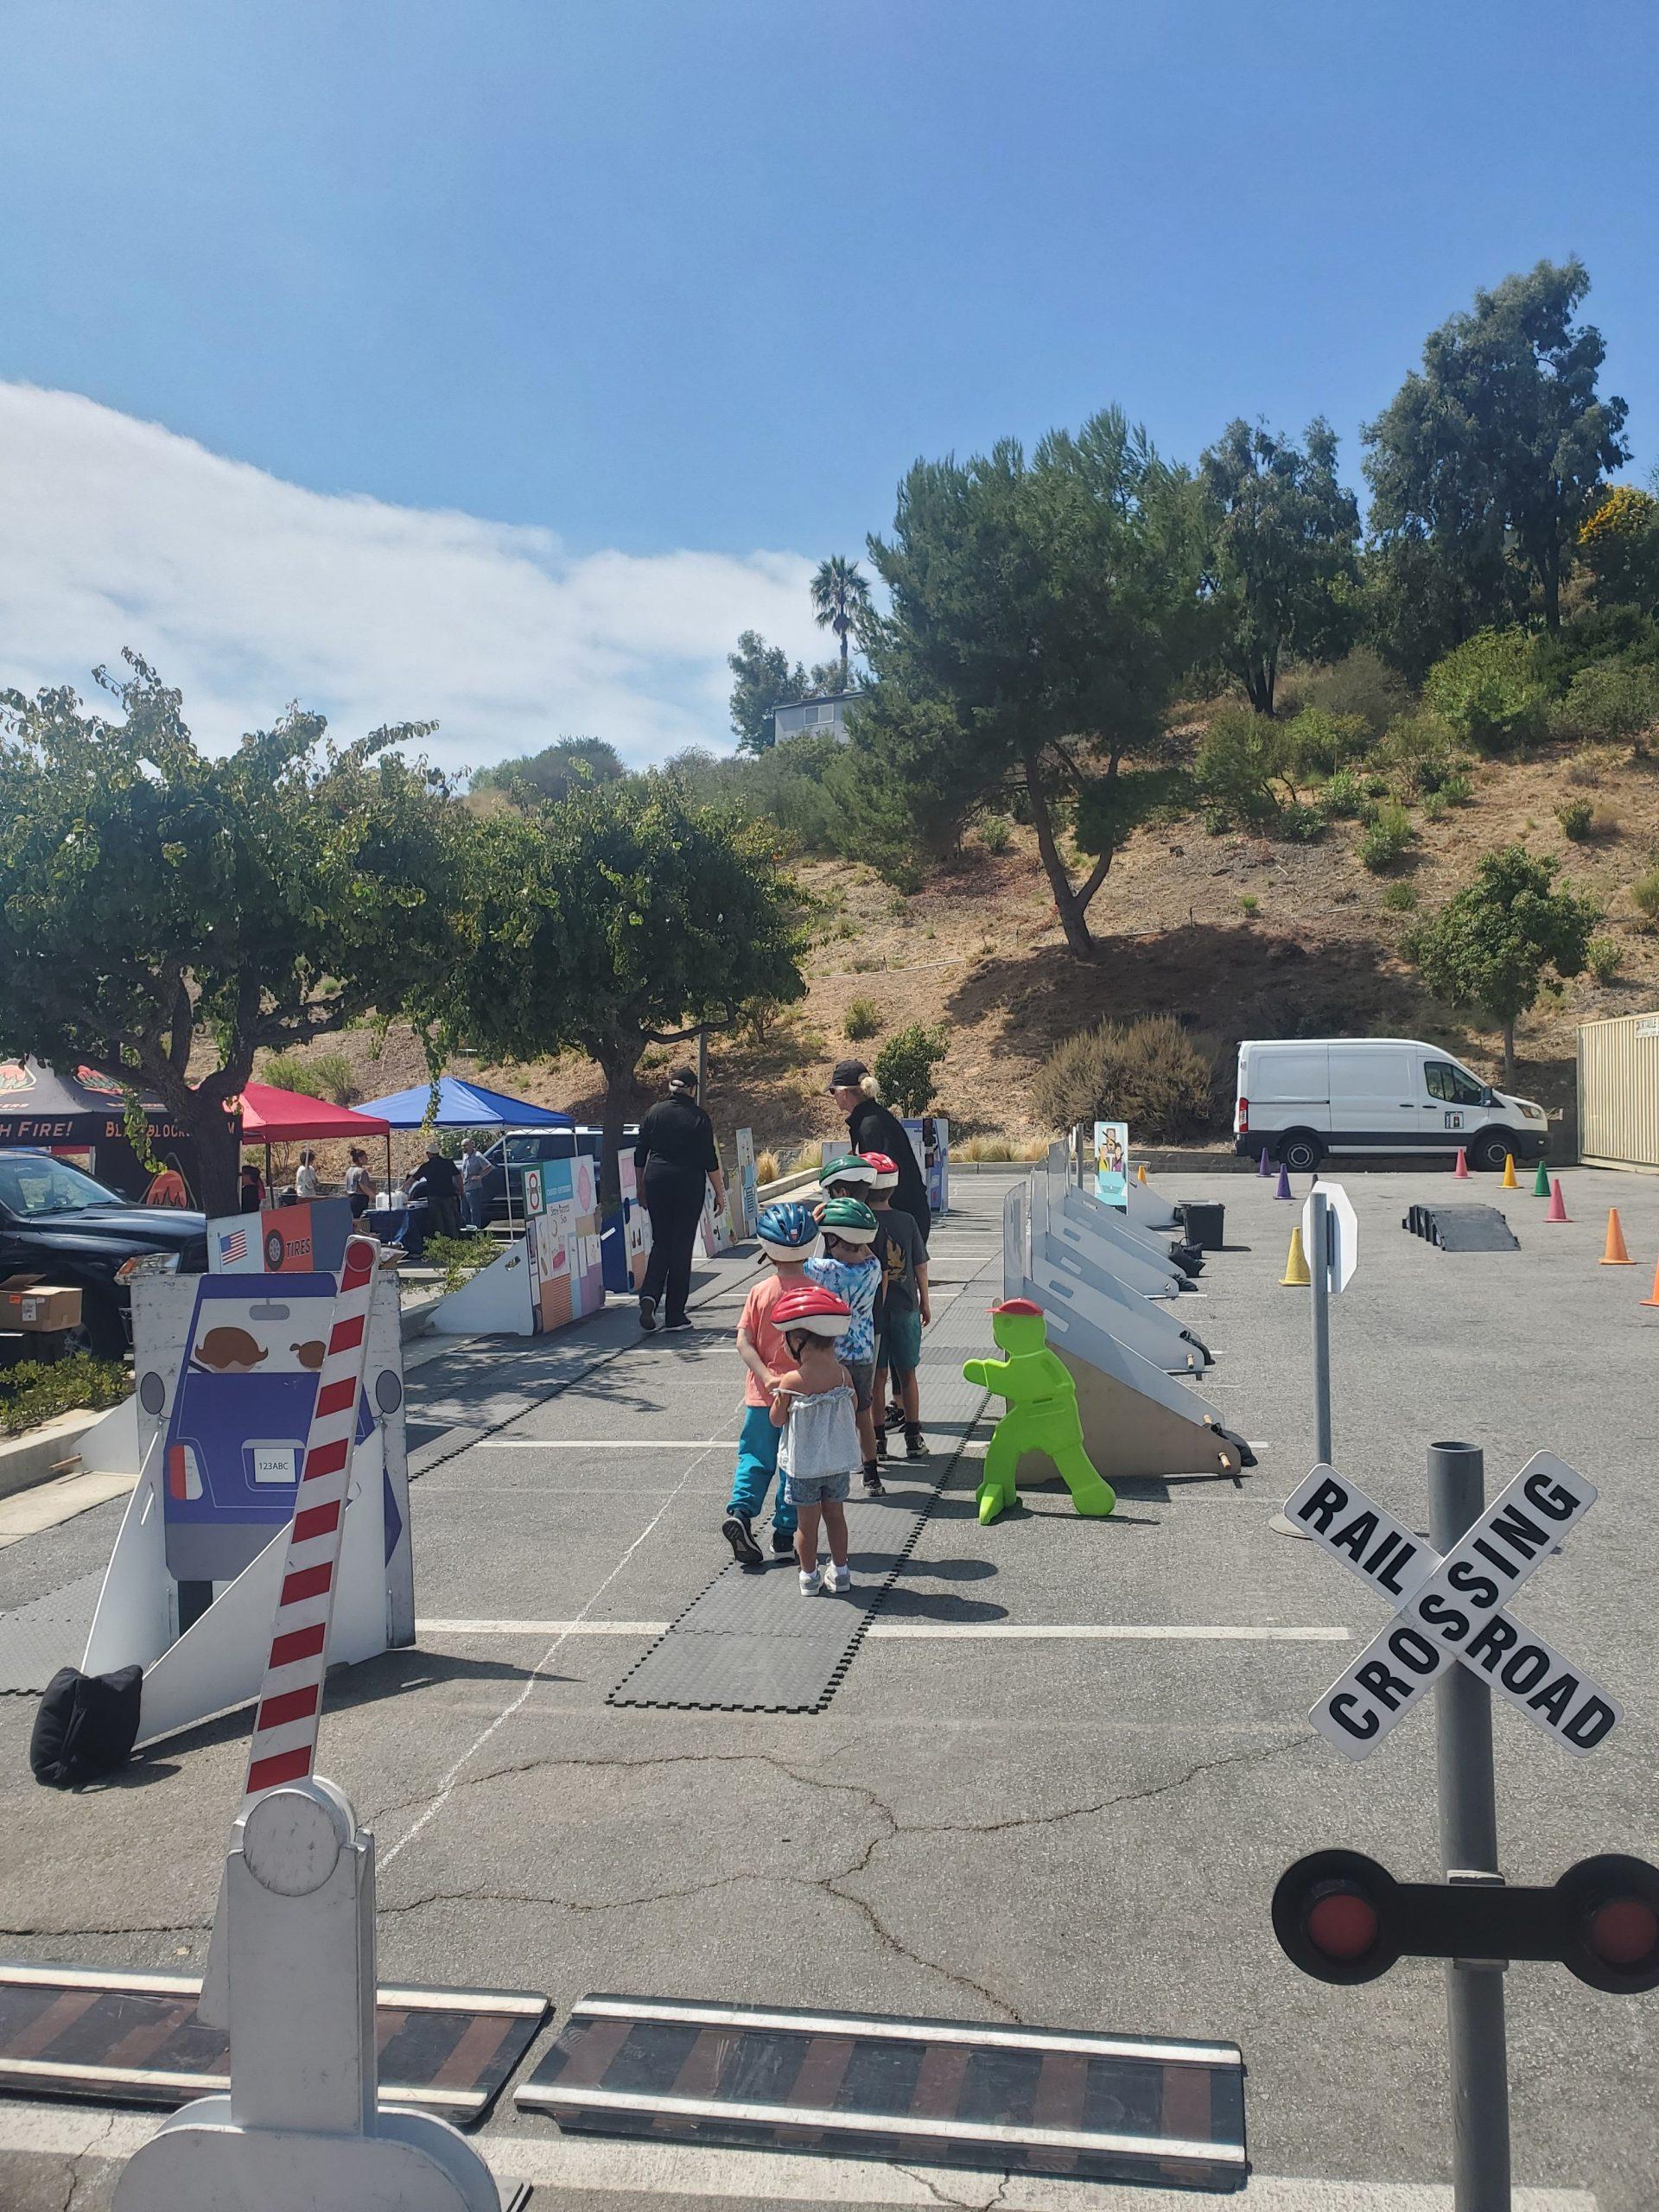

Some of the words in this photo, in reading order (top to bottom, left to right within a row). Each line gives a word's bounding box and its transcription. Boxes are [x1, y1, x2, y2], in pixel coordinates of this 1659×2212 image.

[17, 1121, 73, 1137] FIRE!
[286, 1237, 311, 1258] TIRES
[1297, 1478, 1417, 1596] RAIL
[1465, 1614, 1616, 1749] ROAD
[1329, 1473, 1581, 1740] CROSSING
